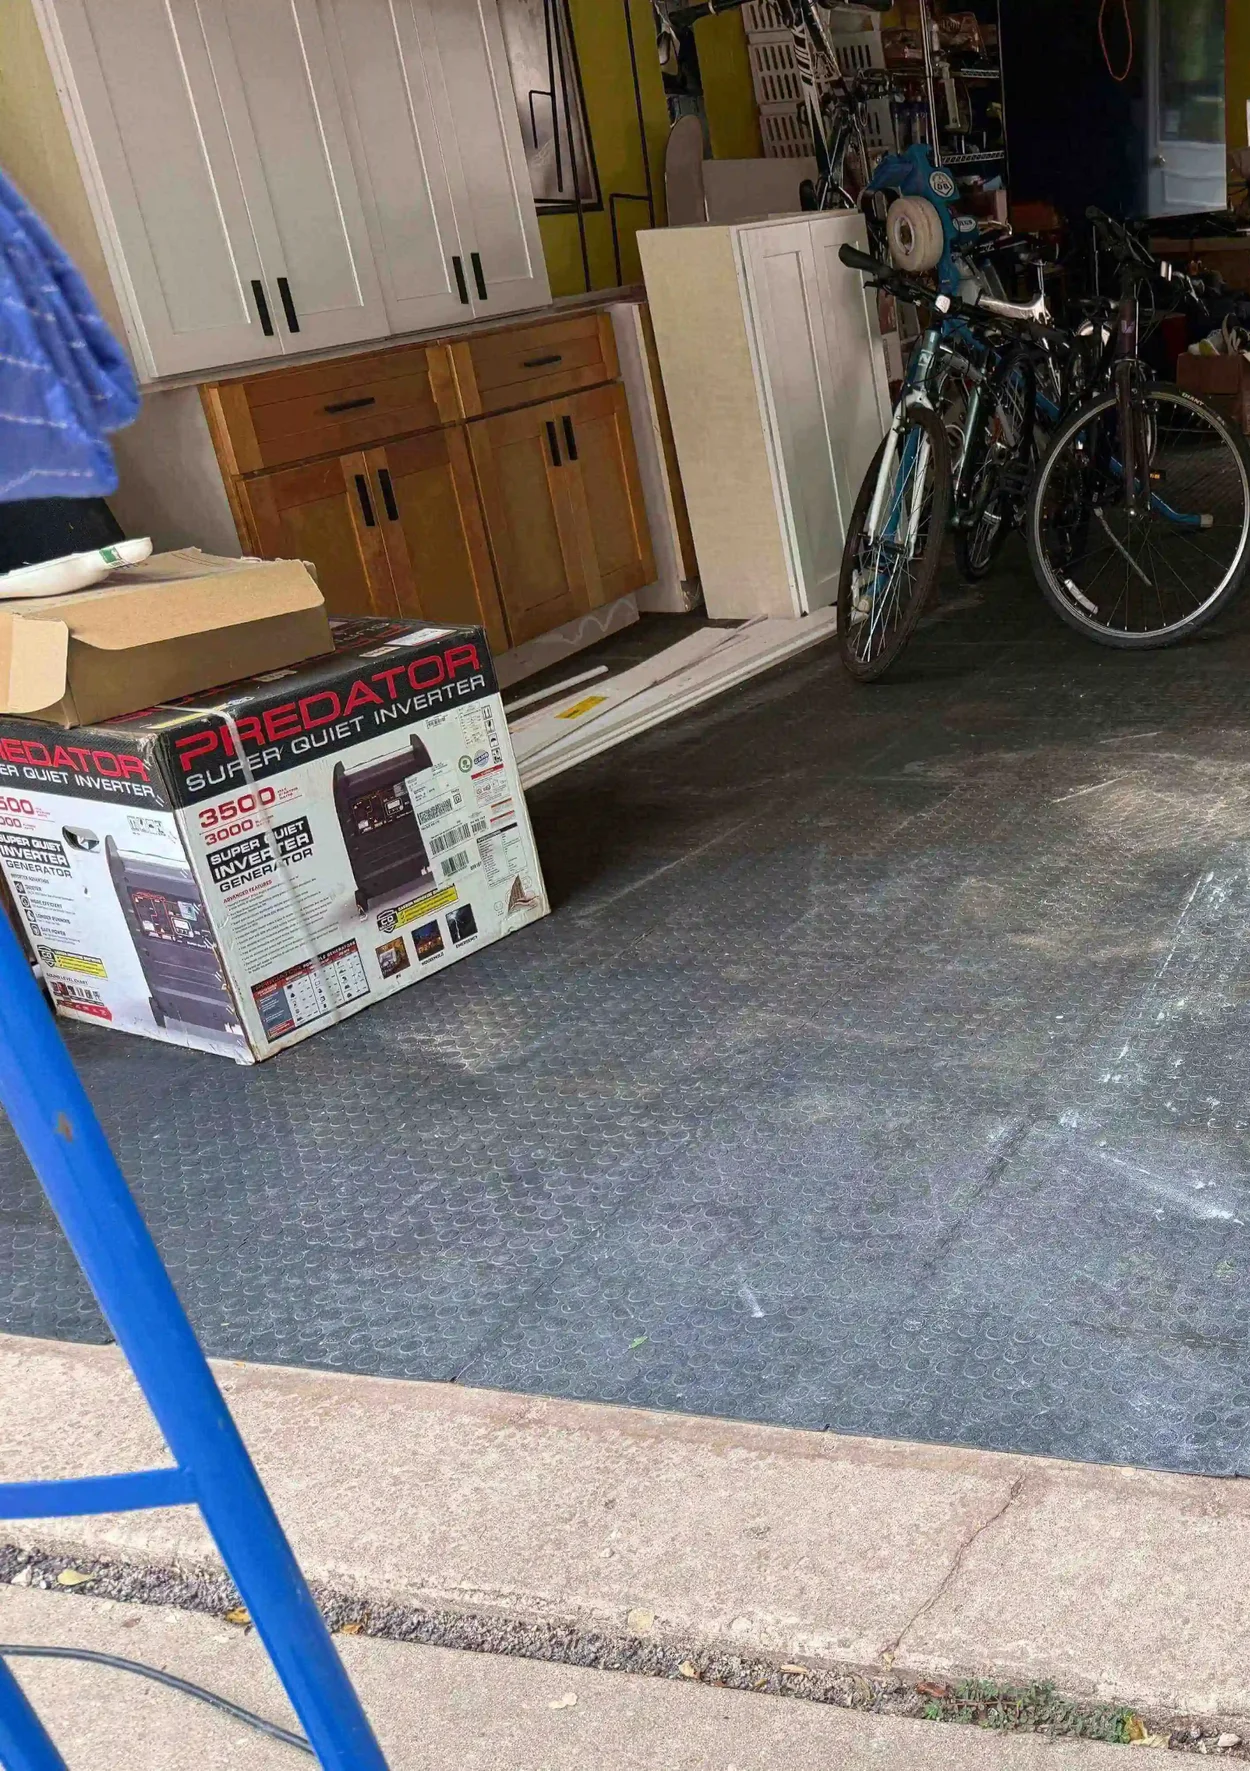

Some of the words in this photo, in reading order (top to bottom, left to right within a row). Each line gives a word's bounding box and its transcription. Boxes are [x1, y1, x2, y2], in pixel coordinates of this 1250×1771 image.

[175, 643, 480, 772] PREDATOR
[186, 747, 283, 793] SUPER
[290, 715, 365, 755] QUIET
[373, 674, 486, 726] INVERTER
[23, 766, 70, 784] QUIET
[74, 774, 156, 799] INVERTER
[198, 786, 276, 829] 3500
[31, 839, 62, 852] QUIET
[203, 818, 254, 847] 3000
[0, 845, 68, 867] INVERTER
[210, 839, 261, 866] SUPER
[6, 859, 73, 879] GENERATOR
